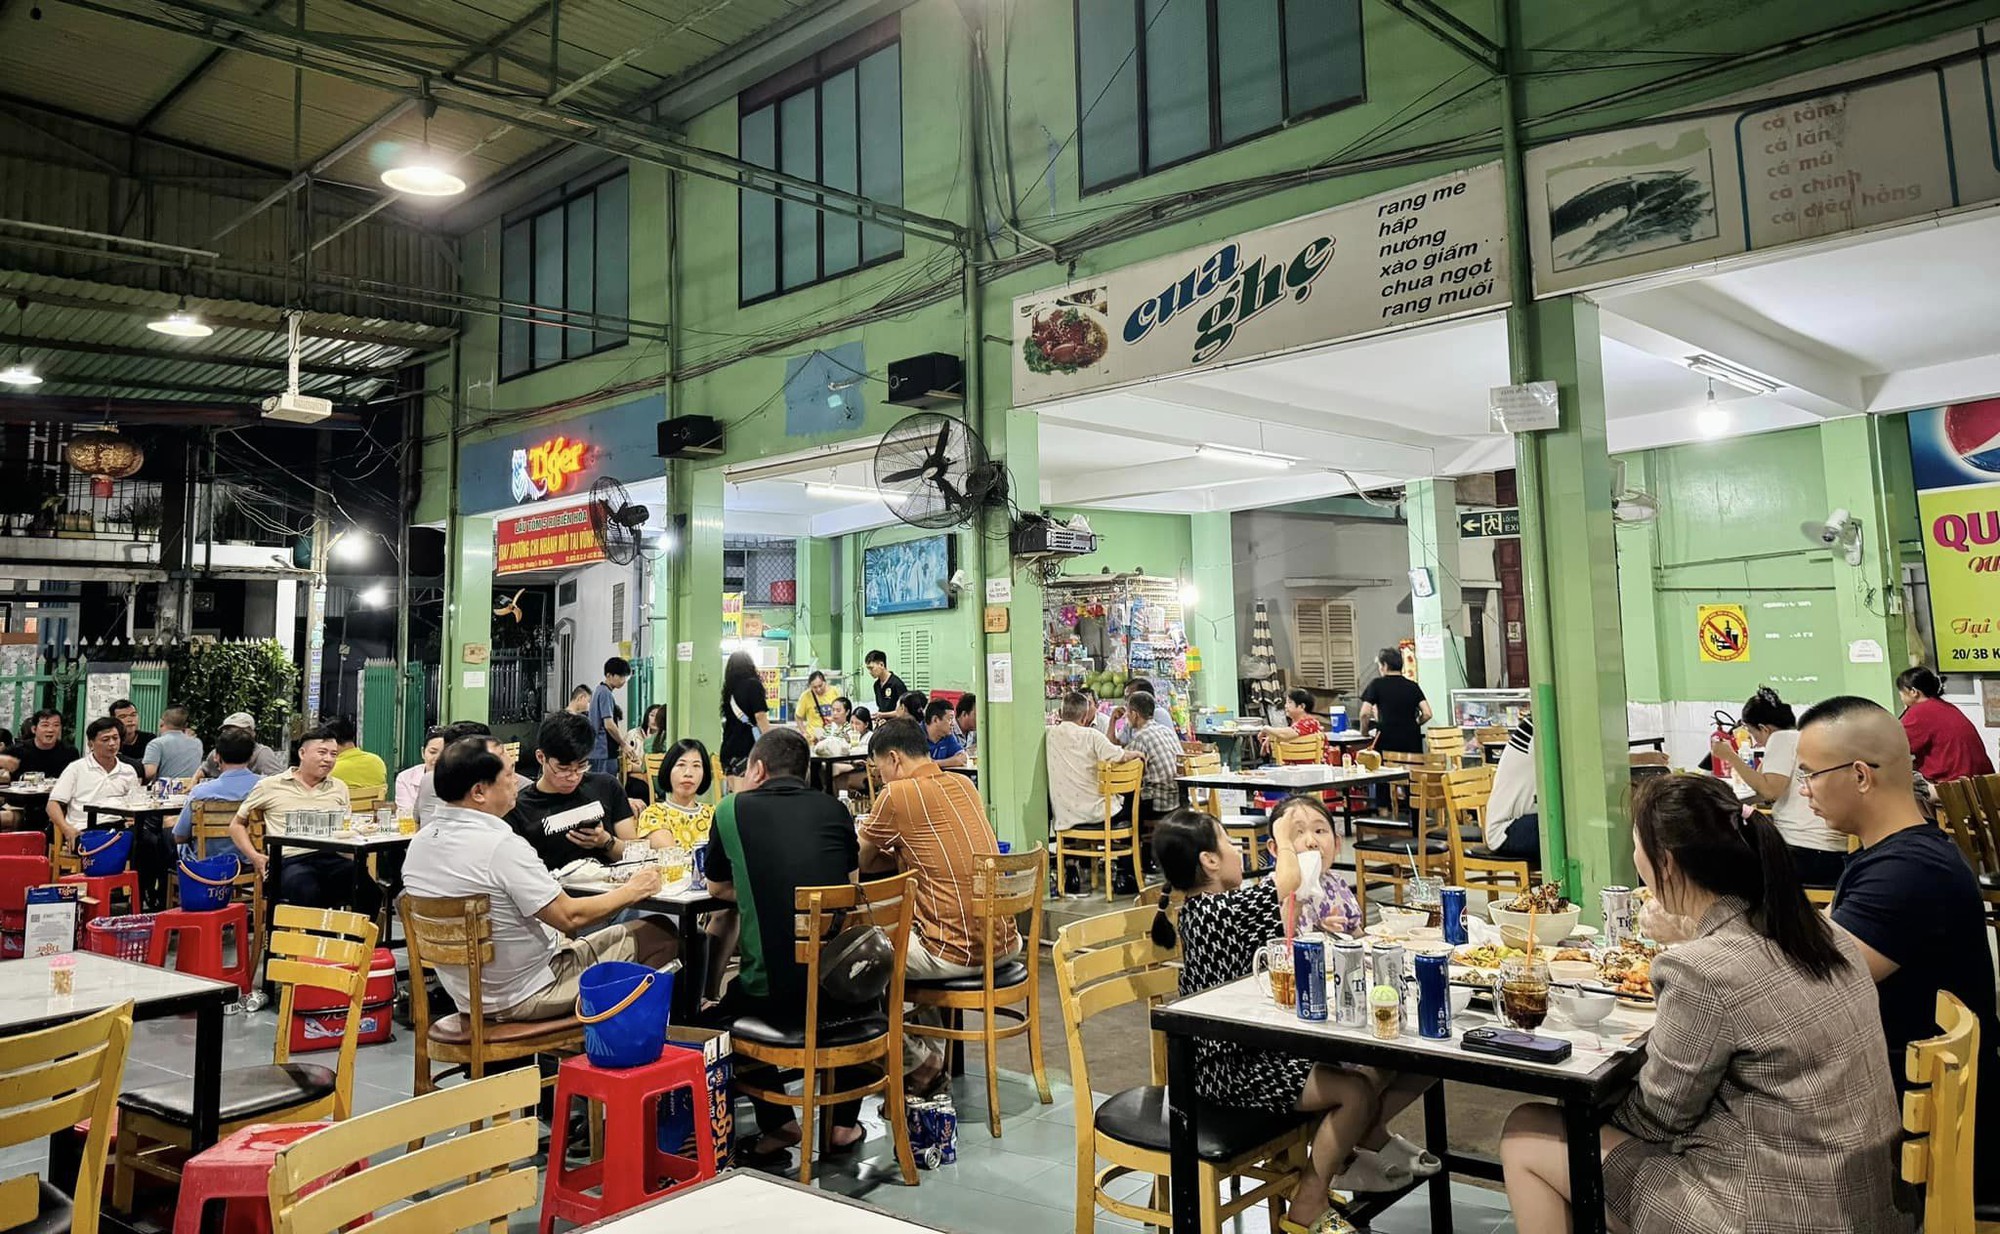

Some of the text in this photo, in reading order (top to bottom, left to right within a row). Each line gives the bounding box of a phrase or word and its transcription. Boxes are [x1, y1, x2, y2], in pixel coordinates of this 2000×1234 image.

[1378, 182, 1466, 217] rang me
[1379, 216, 1418, 237] hấp
[1379, 229, 1447, 258] nướng
[1380, 243, 1478, 278] xào giấm
[1381, 257, 1492, 297] chua ngọt
[1123, 243, 1242, 343] cua
[1192, 236, 1335, 364] ghẹ
[1382, 278, 1494, 318] rang muối
[529, 436, 583, 491] Tiger
[1505, 524, 1519, 532] EXI
[711, 1089, 733, 1162] Tiger
